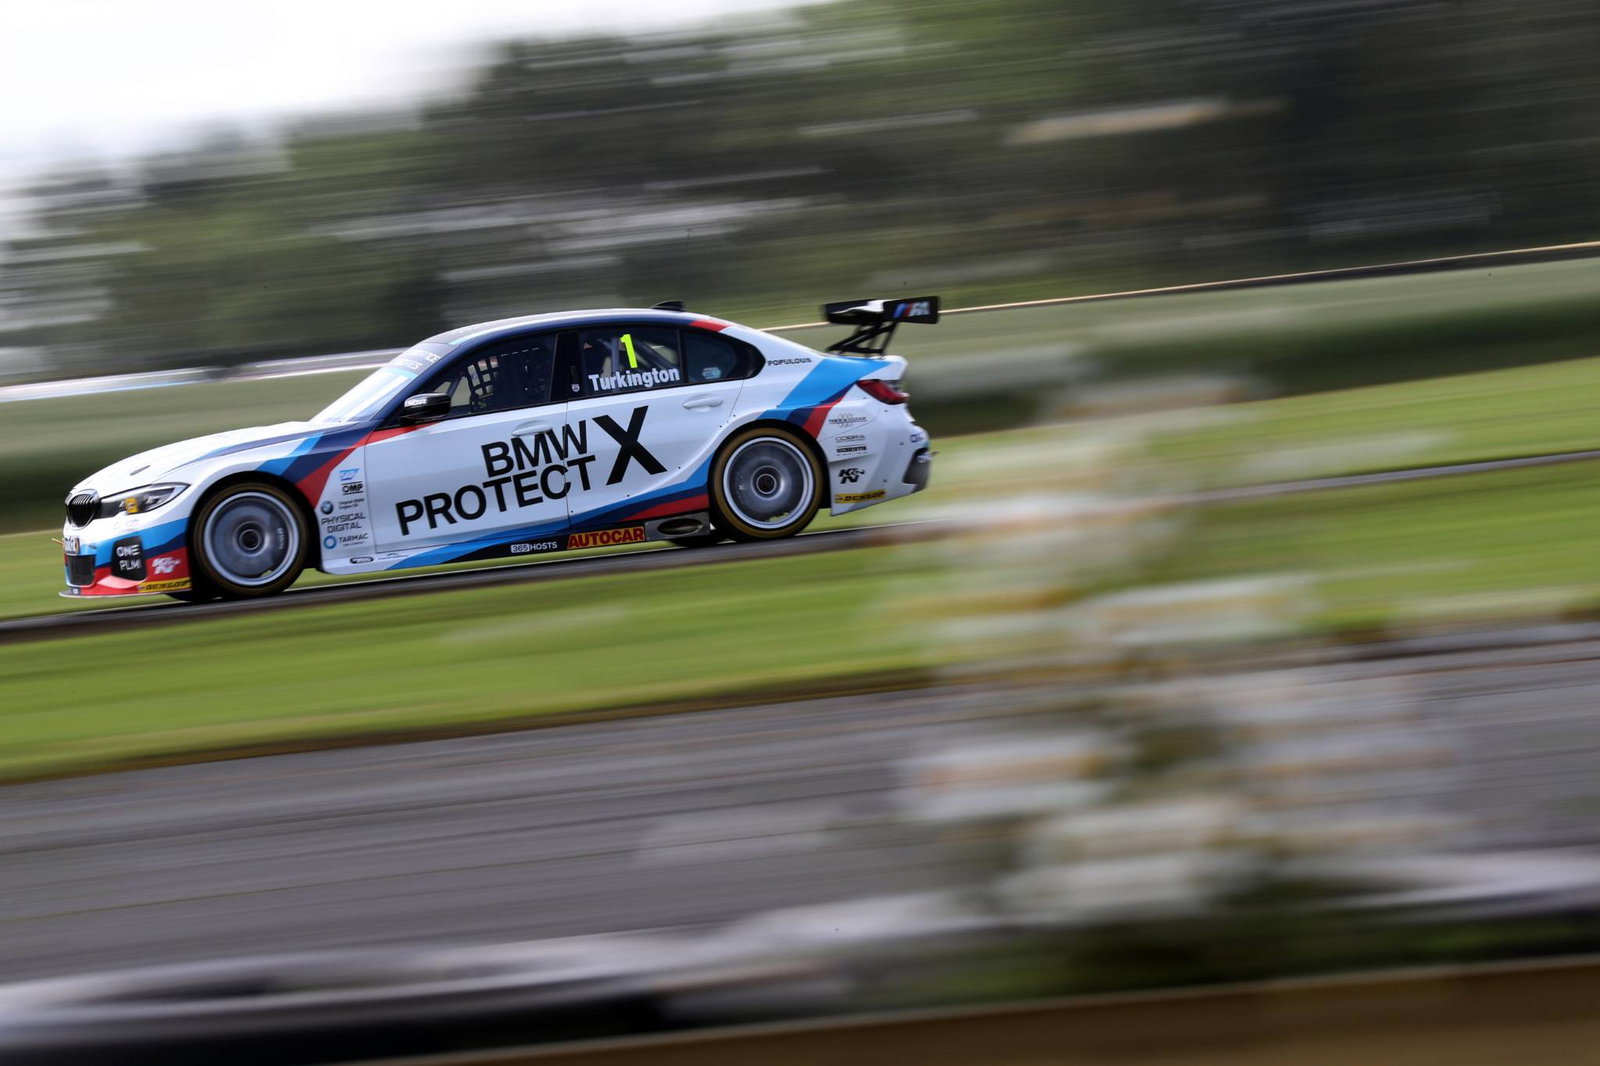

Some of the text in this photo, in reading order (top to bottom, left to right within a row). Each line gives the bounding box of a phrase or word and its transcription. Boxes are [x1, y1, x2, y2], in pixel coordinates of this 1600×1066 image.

[620, 334, 638, 368] 1
[767, 357, 812, 366] POPULOUS
[588, 368, 680, 391] Turkington
[481, 420, 588, 478] BMW
[592, 405, 667, 486] X
[342, 483, 364, 493] OMP
[395, 455, 595, 536] PROTECT
[321, 511, 367, 525] PHYSICAL
[326, 521, 362, 533] DIGITAL
[338, 532, 369, 543] TARMAC
[567, 526, 645, 549] AUTOCAR
[116, 544, 140, 557] ONE
[120, 560, 140, 571] PLM
